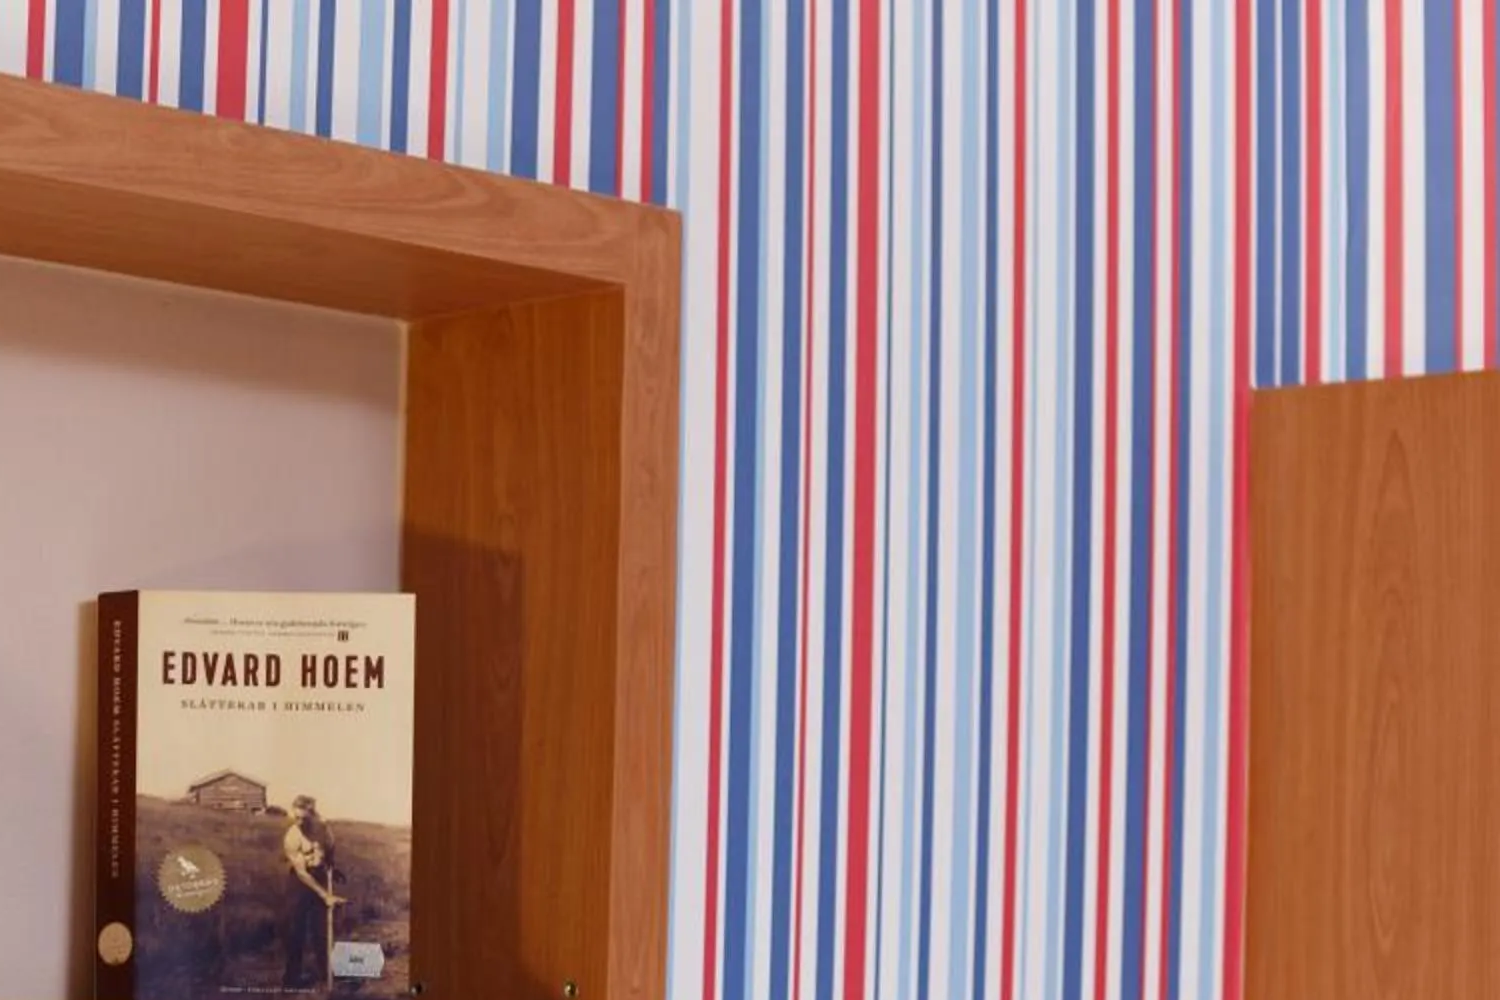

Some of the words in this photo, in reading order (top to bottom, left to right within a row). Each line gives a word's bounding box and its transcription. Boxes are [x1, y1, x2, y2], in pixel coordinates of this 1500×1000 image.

[162, 650, 281, 688] EDVARD
[301, 653, 385, 689] HOEM
[283, 701, 366, 712] HIMMELEN
